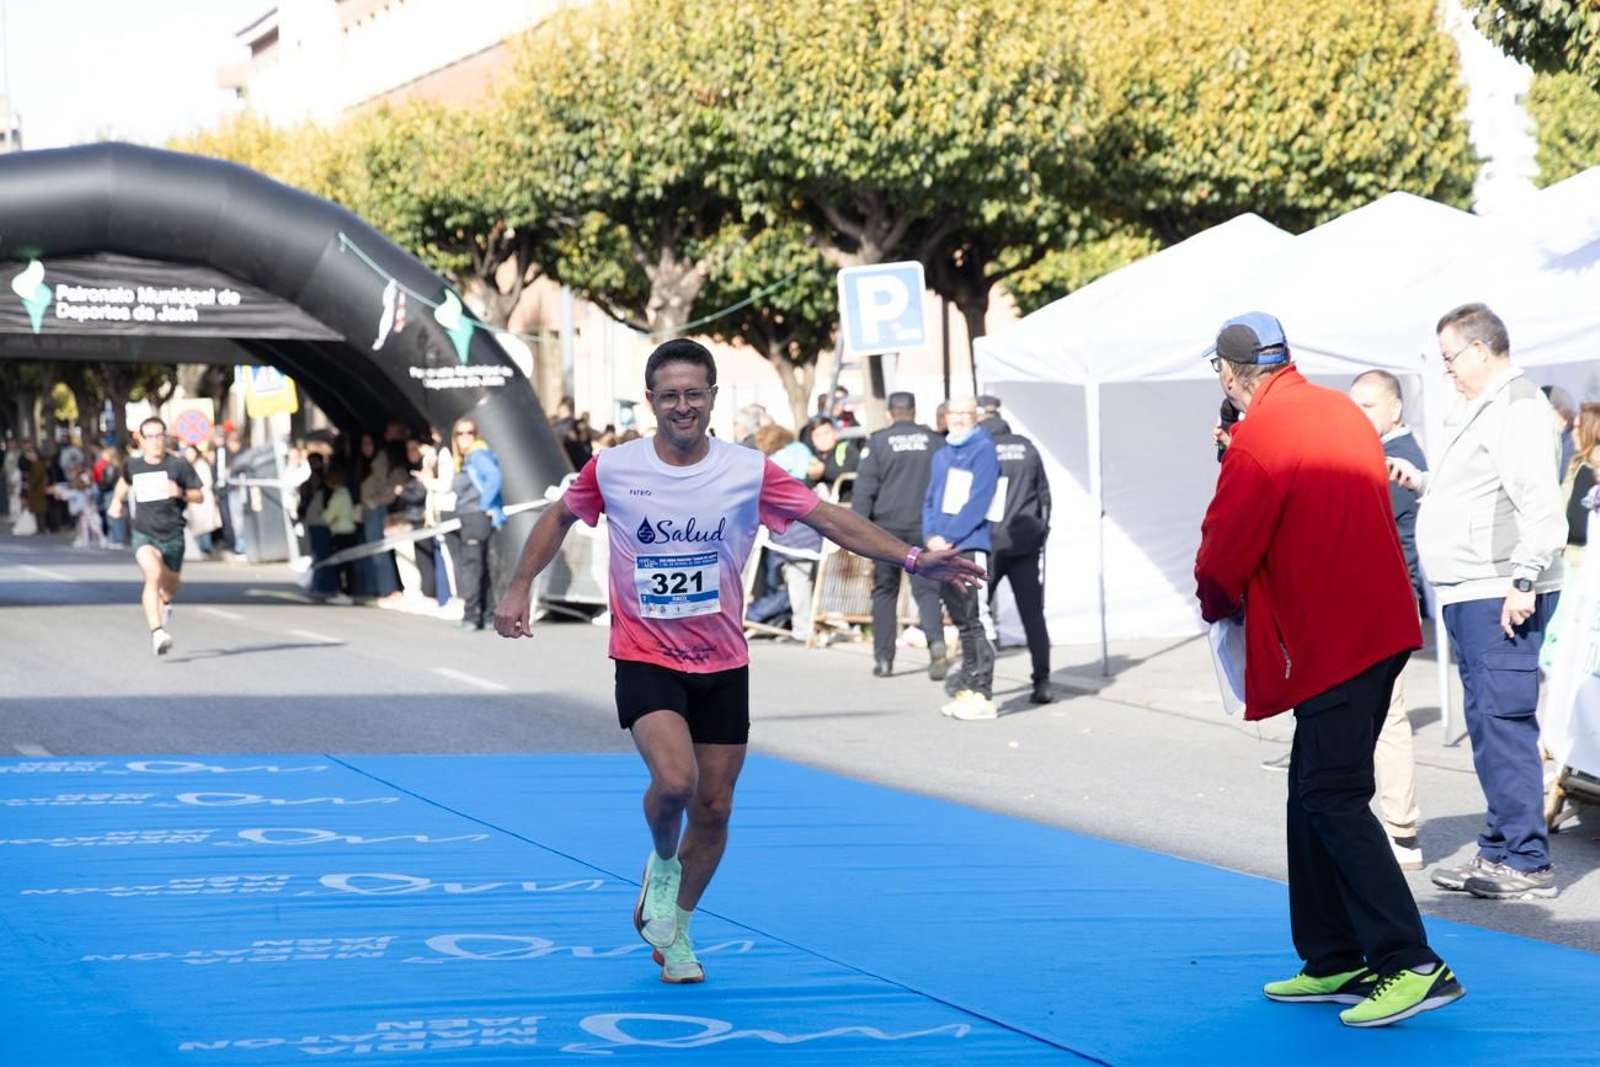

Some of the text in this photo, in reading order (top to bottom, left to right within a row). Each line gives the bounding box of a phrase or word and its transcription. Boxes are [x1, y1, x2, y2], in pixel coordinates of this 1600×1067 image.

[55, 284, 241, 307] Patronato Municipal de
[55, 302, 199, 322] Deportes de Jaén
[856, 274, 908, 345] P
[654, 516, 726, 544] Salud
[651, 570, 702, 594] 321
[178, 1026, 538, 1052] MARATON
[297, 1036, 536, 1055] MEDIA
